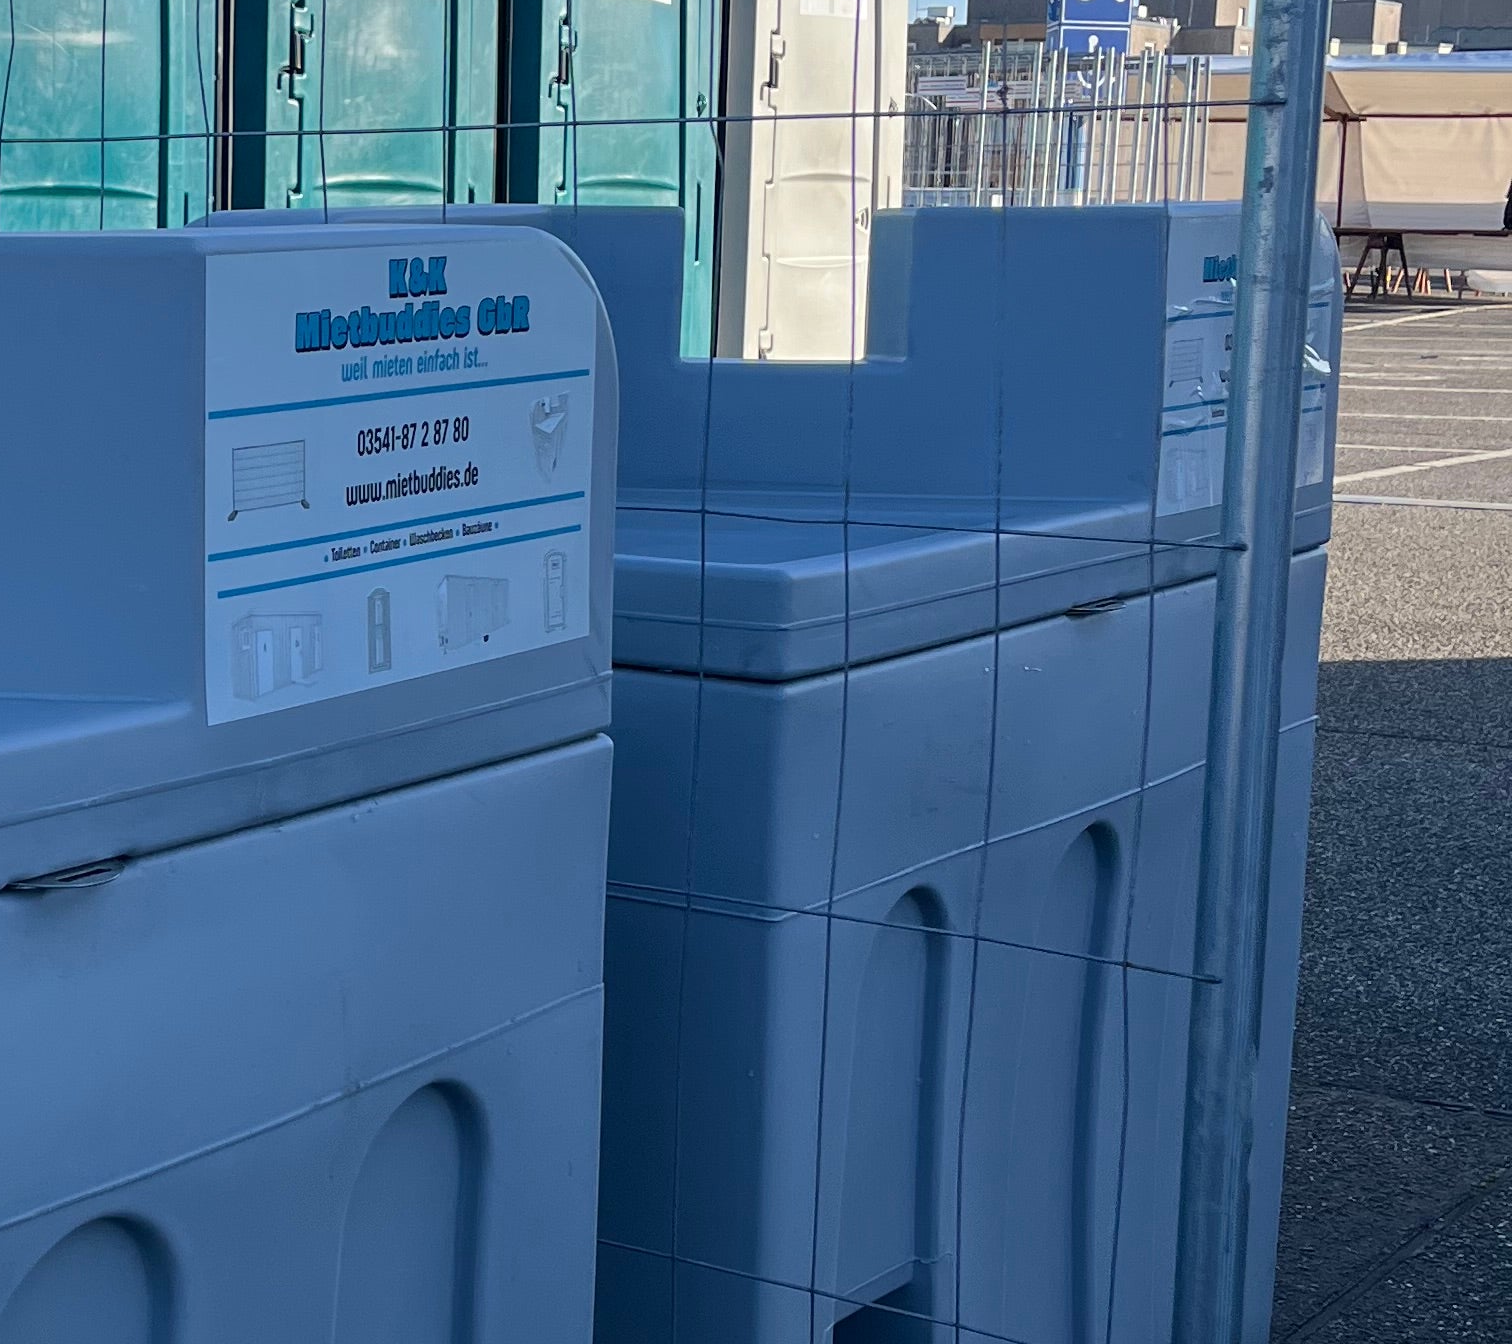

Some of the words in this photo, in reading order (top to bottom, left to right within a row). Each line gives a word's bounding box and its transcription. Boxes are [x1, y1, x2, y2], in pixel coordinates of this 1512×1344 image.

[389, 256, 447, 298] K&K
[295, 300, 471, 353] Mietbuddies
[477, 295, 530, 336] GbR
[341, 355, 369, 382] weil
[372, 354, 413, 379] mieten
[417, 346, 460, 373] einfach
[357, 422, 417, 456] 03541-87
[421, 421, 429, 447] 2
[433, 418, 449, 445] 87
[453, 416, 469, 443] 80
[345, 460, 479, 507] www.mietbuddies.de
[369, 537, 401, 554] Container
